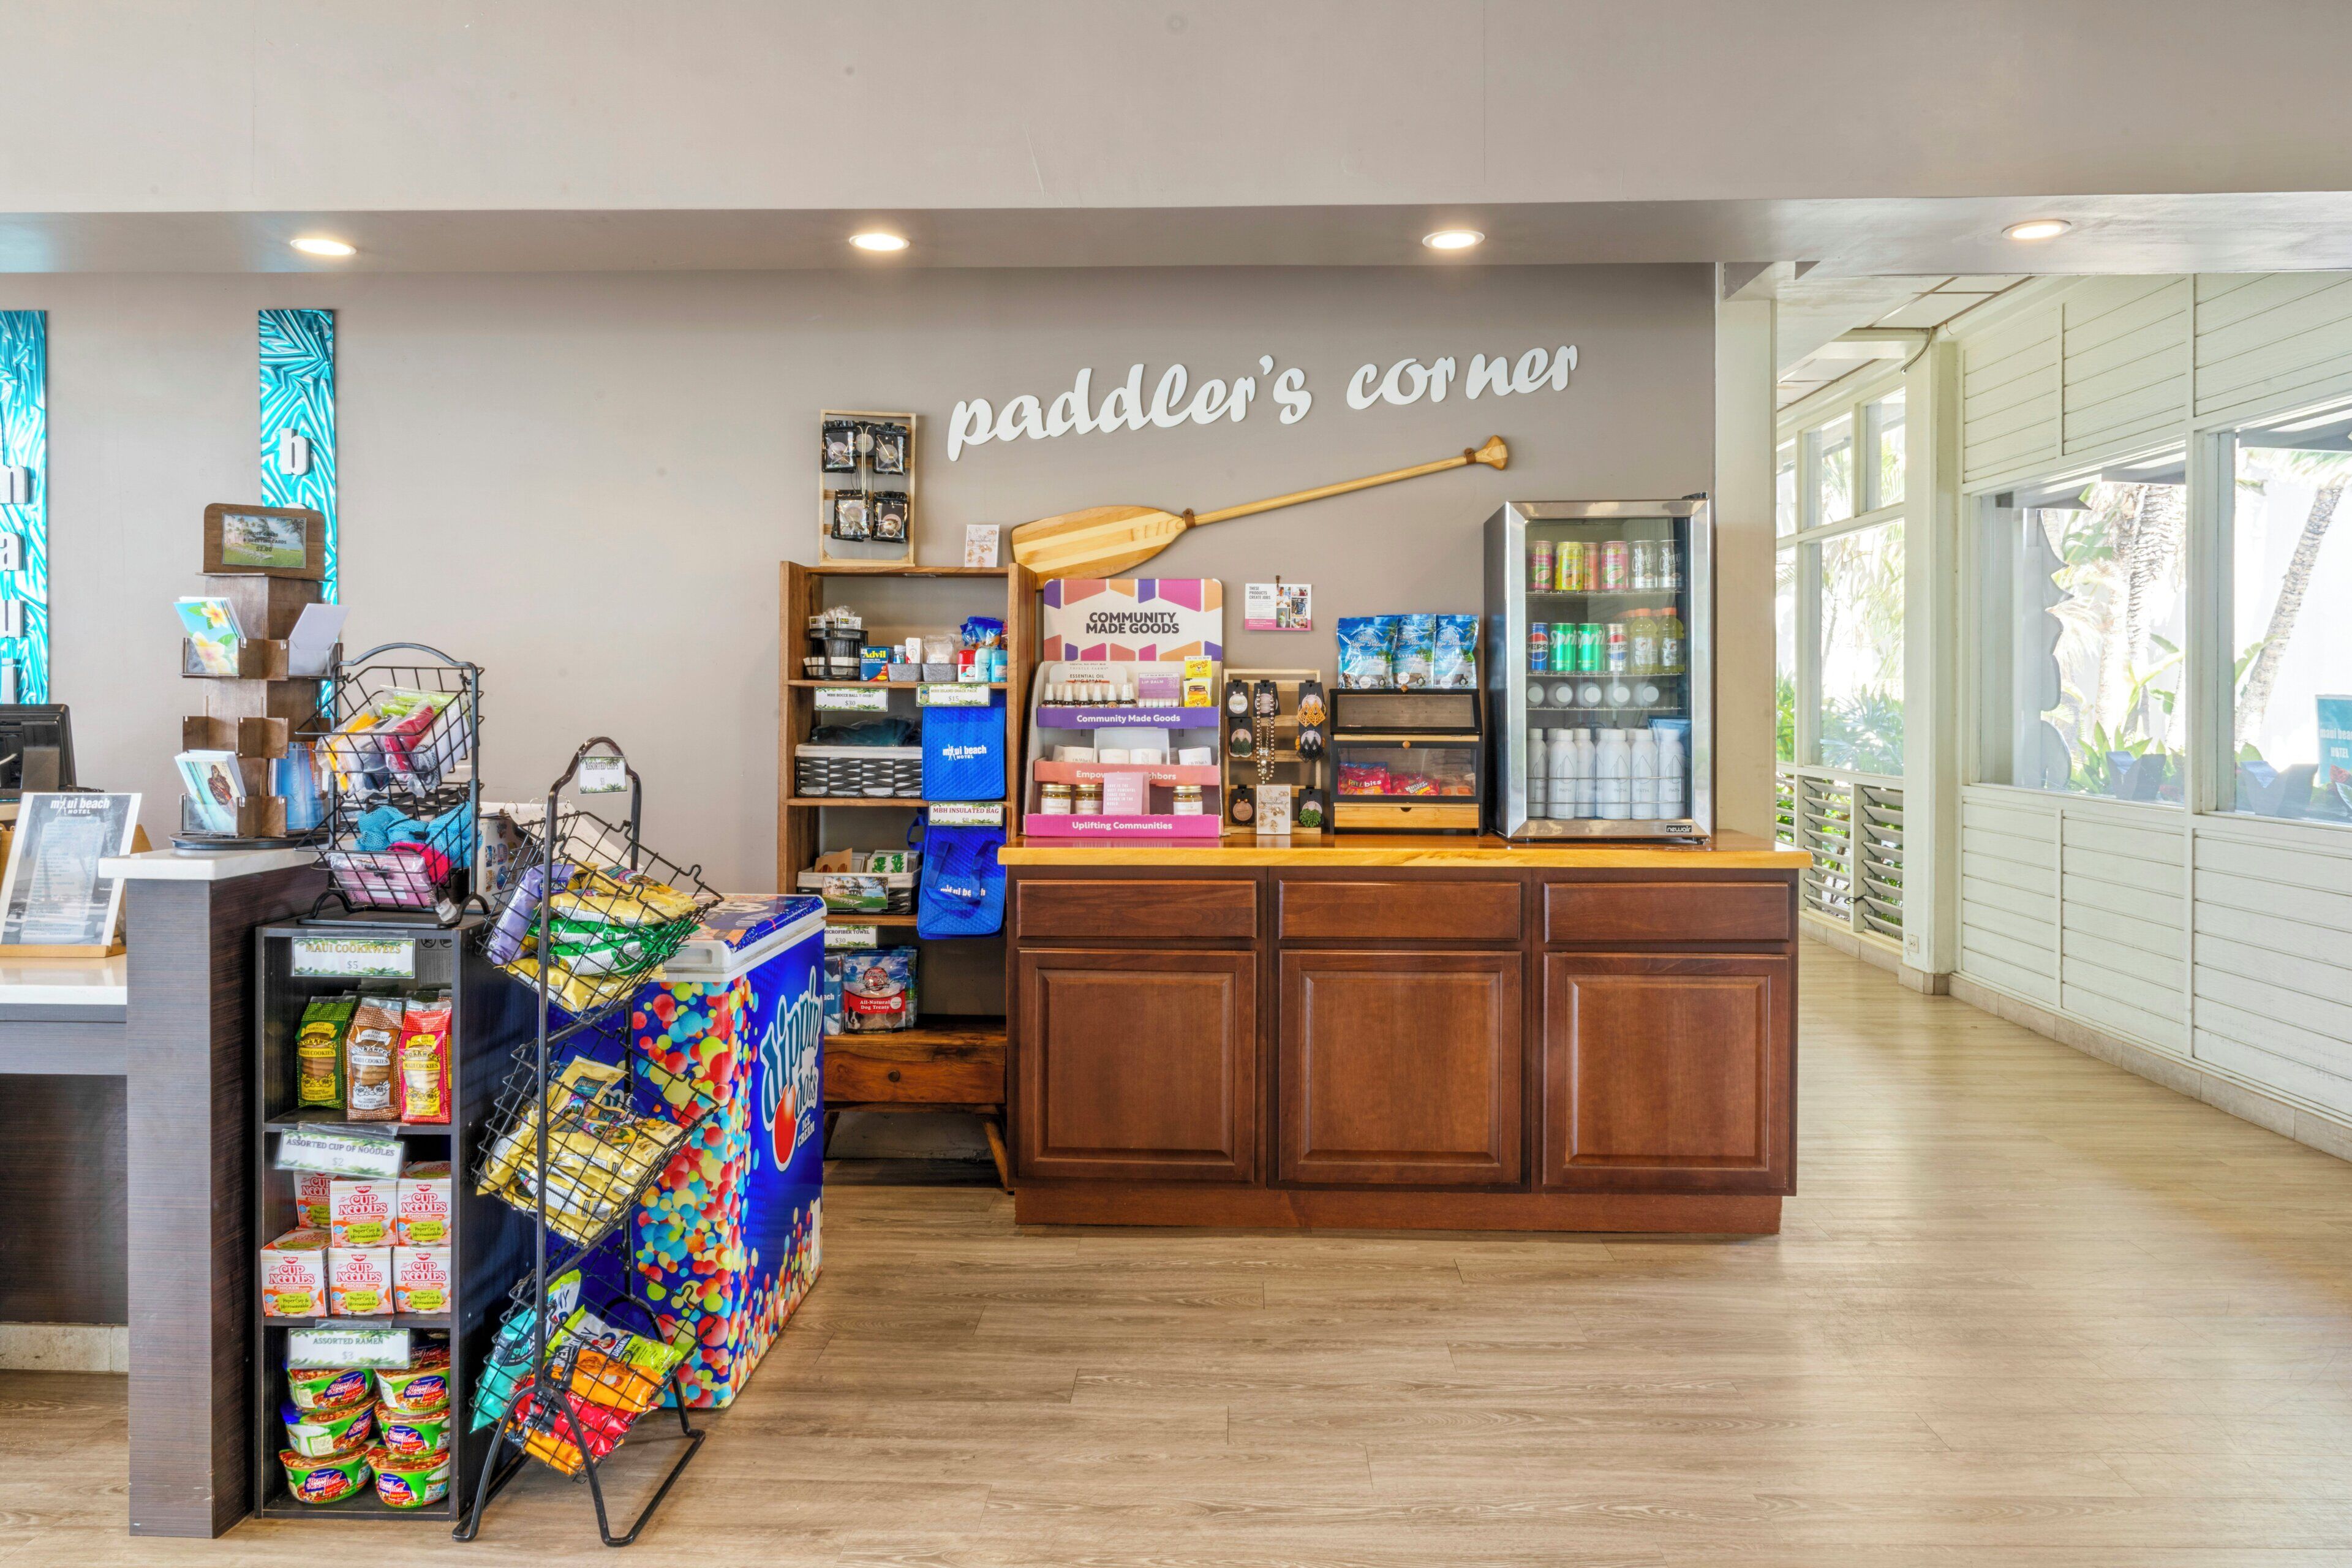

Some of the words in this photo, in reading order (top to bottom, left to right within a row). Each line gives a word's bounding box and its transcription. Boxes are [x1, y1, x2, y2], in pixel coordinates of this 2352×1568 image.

[947, 354, 1312, 462] paddler's
[1346, 344, 1578, 410] corner
[1089, 612, 1177, 623] COMMUNITY
[1085, 624, 1126, 634] MADE
[1129, 623, 1180, 634] GOODS
[1189, 660, 1208, 669] GROUND
[1077, 715, 1126, 724] Community
[2320, 728, 2337, 739] maui
[963, 745, 987, 755] beach
[2331, 747, 2349, 758] HOTEL
[585, 761, 606, 770] ASSORTED
[1364, 779, 1382, 788] bits
[79, 797, 111, 809] beach
[1072, 821, 1112, 831] Uplifting
[306, 943, 333, 953] MAUI
[347, 960, 358, 970] $5
[796, 1066, 817, 1115] dots
[802, 1114, 810, 1130] ICE
[797, 1125, 815, 1147] CREAM
[286, 1138, 327, 1149] ASSORTED
[358, 1146, 395, 1156] NOODLES
[332, 1157, 344, 1166] $2
[350, 1194, 378, 1205] CUP
[412, 1193, 437, 1203] CUP
[339, 1202, 388, 1216] NOODLES
[401, 1202, 448, 1213] NOODLES
[279, 1265, 305, 1275] CUP
[347, 1262, 373, 1273] CUP
[411, 1261, 437, 1272] CUP
[270, 1273, 315, 1284] NOODLES
[336, 1272, 383, 1283] NOODLES
[401, 1270, 447, 1281] NOODLES
[342, 1351, 353, 1360] $3
